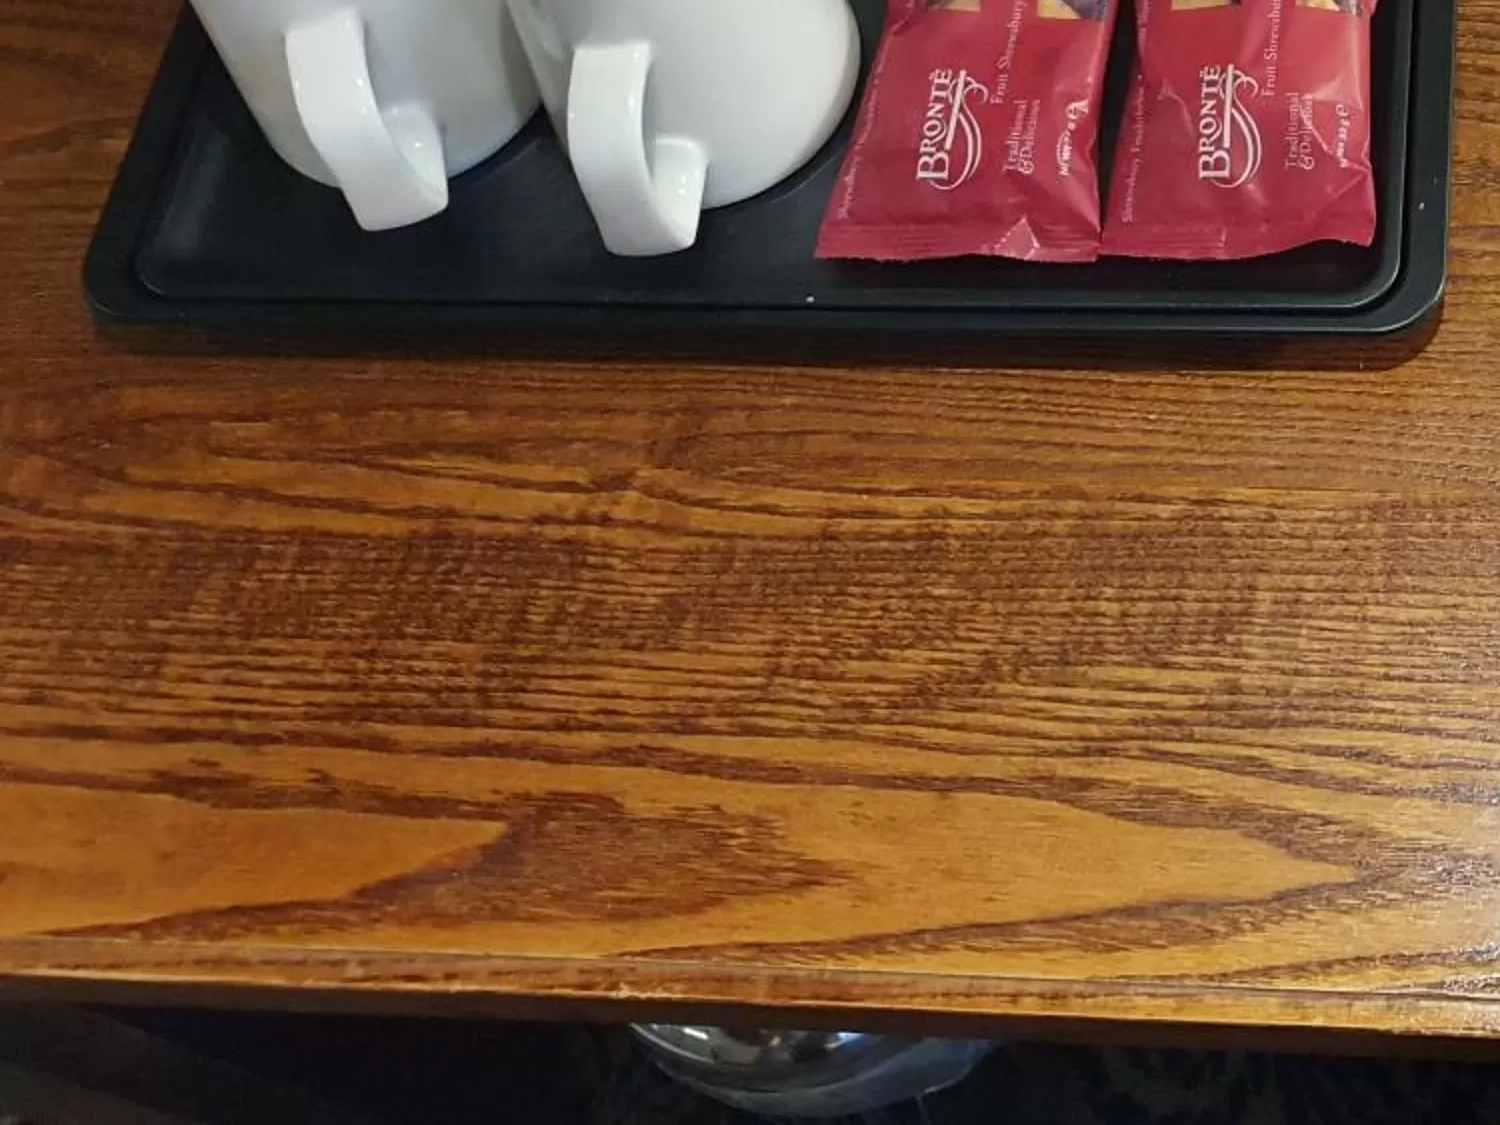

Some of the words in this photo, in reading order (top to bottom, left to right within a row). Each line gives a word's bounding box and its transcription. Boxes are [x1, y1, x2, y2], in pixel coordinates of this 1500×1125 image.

[989, 72, 1010, 105] Fruit
[1260, 65, 1278, 97] Fruit
[1284, 91, 1300, 170] Traditional
